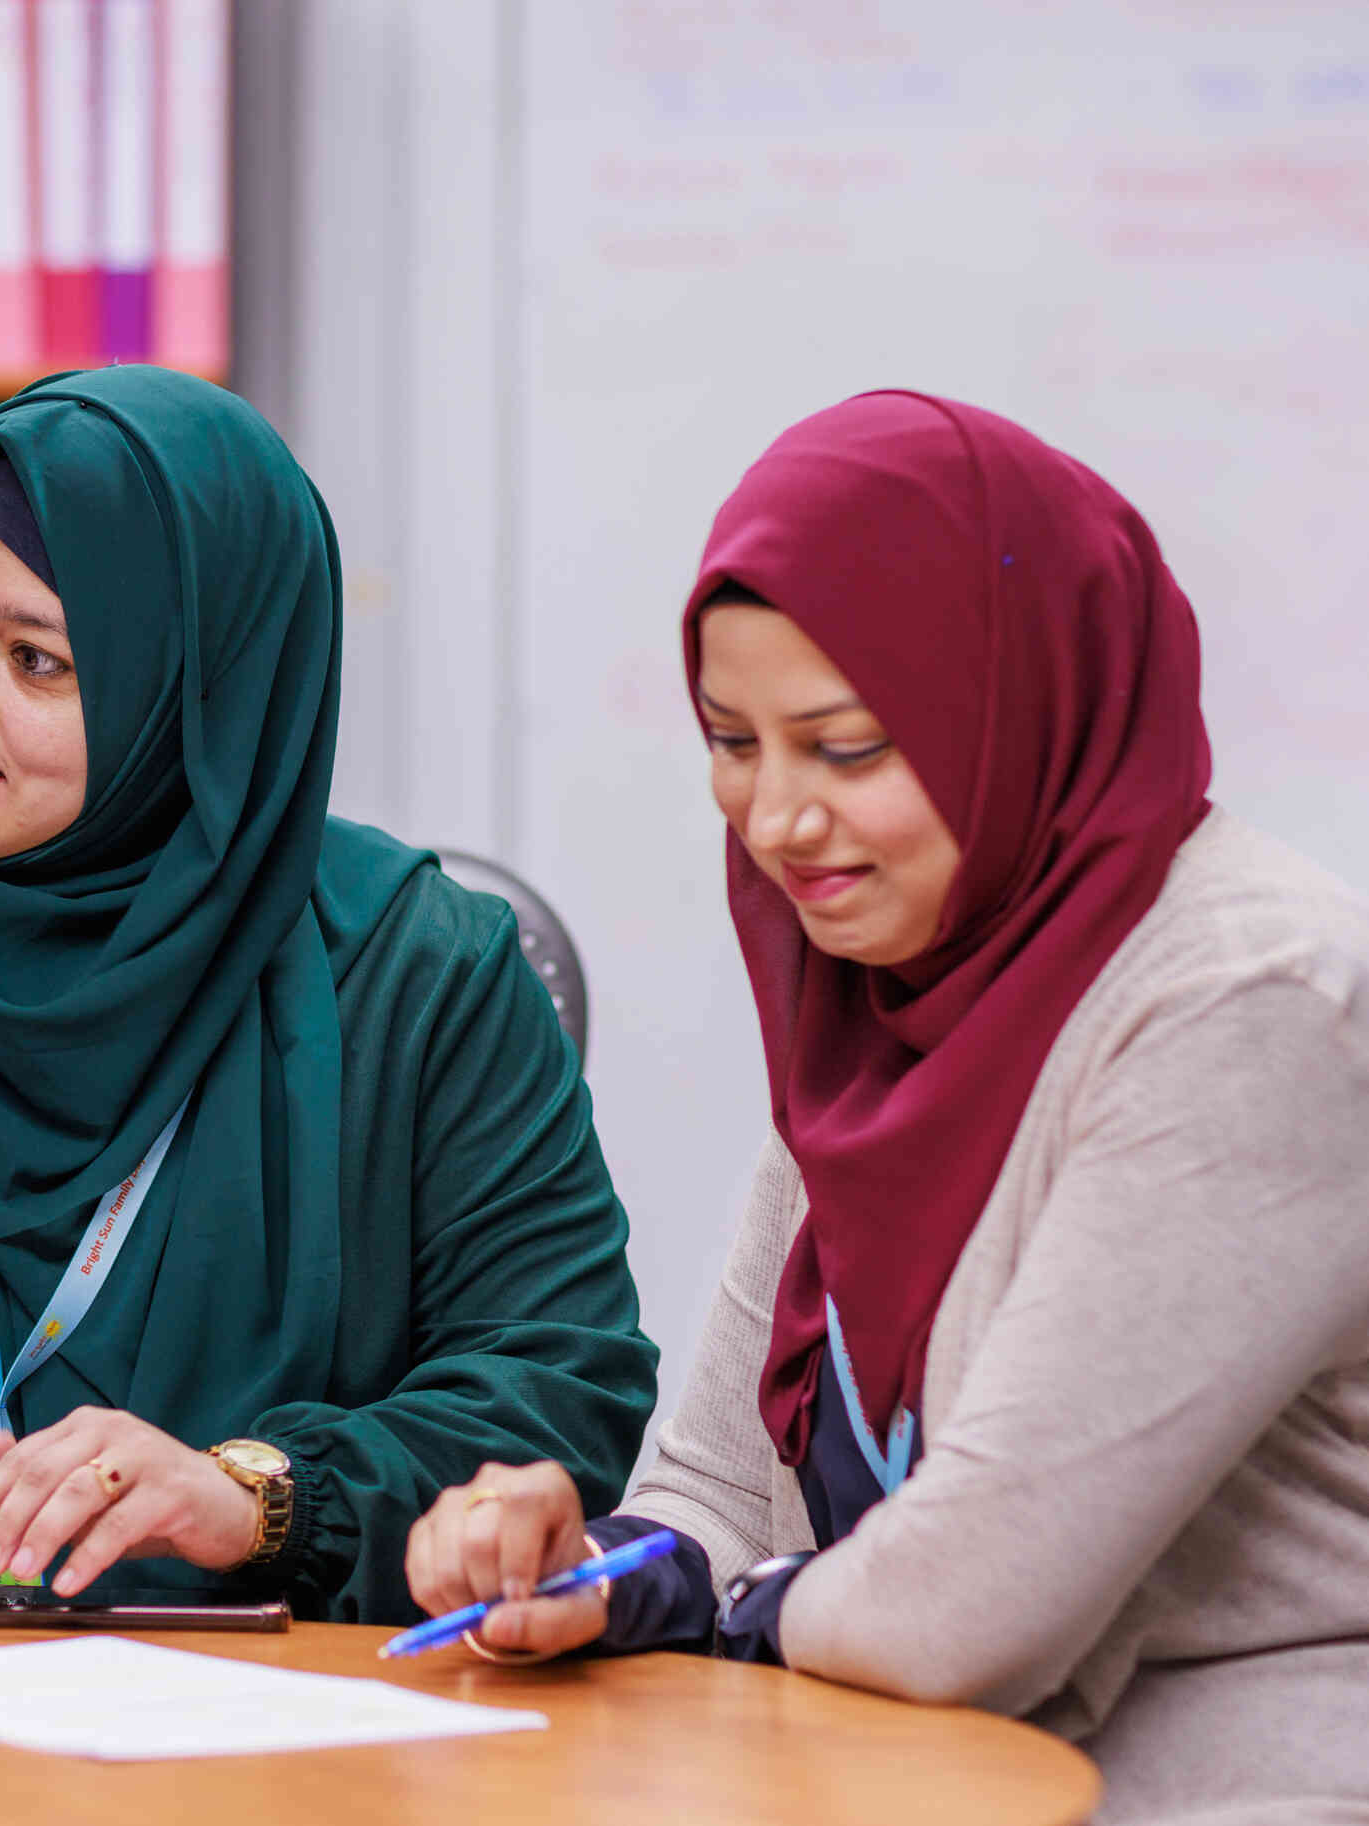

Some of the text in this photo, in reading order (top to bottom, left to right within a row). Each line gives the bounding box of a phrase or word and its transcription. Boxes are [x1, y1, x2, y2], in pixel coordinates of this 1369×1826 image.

[81, 1178, 136, 1275] Bright Sun Family
